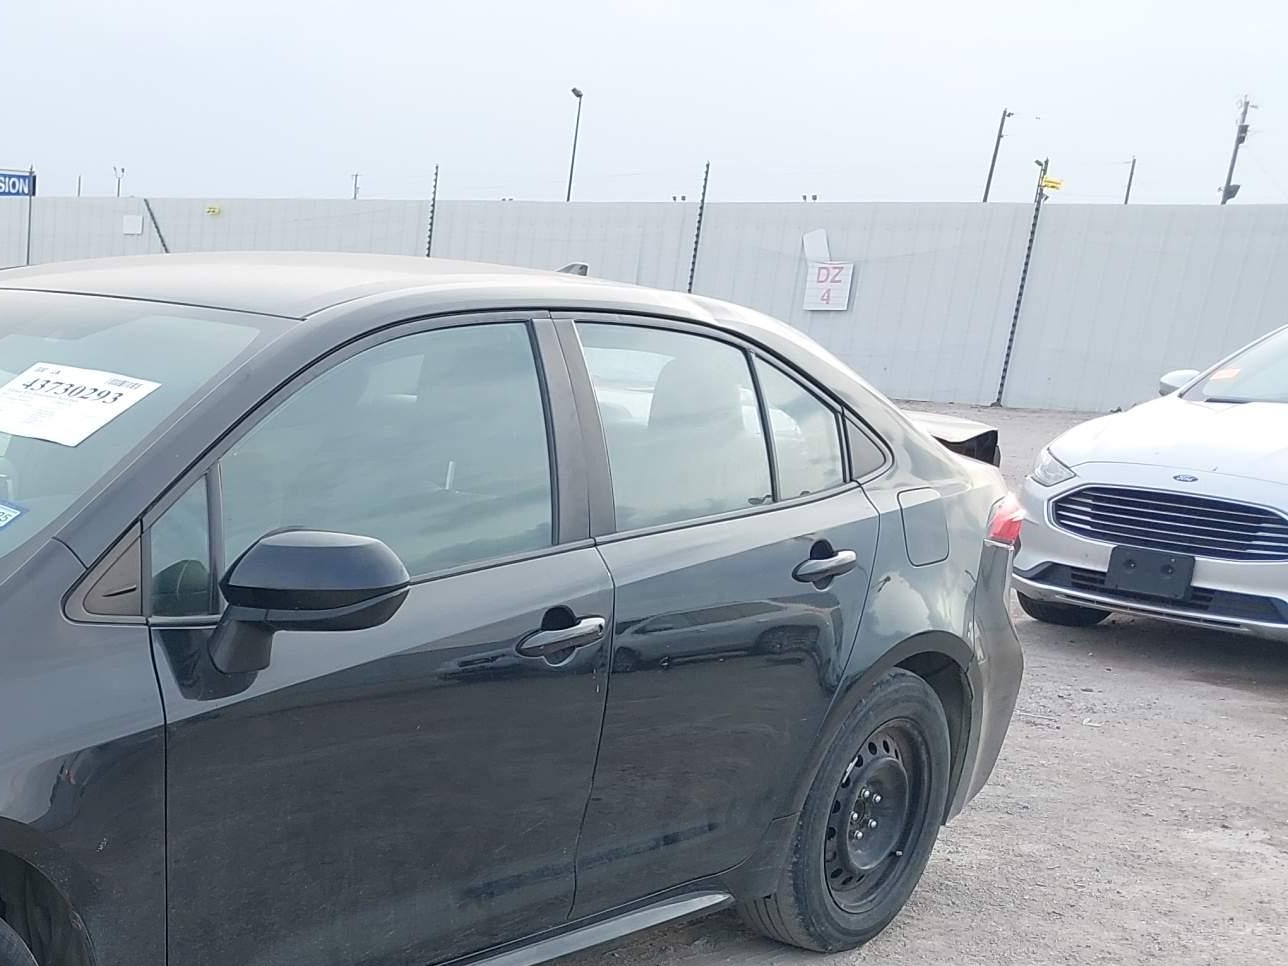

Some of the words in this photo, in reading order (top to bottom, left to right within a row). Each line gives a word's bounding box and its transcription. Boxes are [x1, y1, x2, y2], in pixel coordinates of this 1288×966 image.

[816, 266, 844, 284] DZ
[820, 288, 832, 305] 4
[22, 377, 124, 404] 43730293
